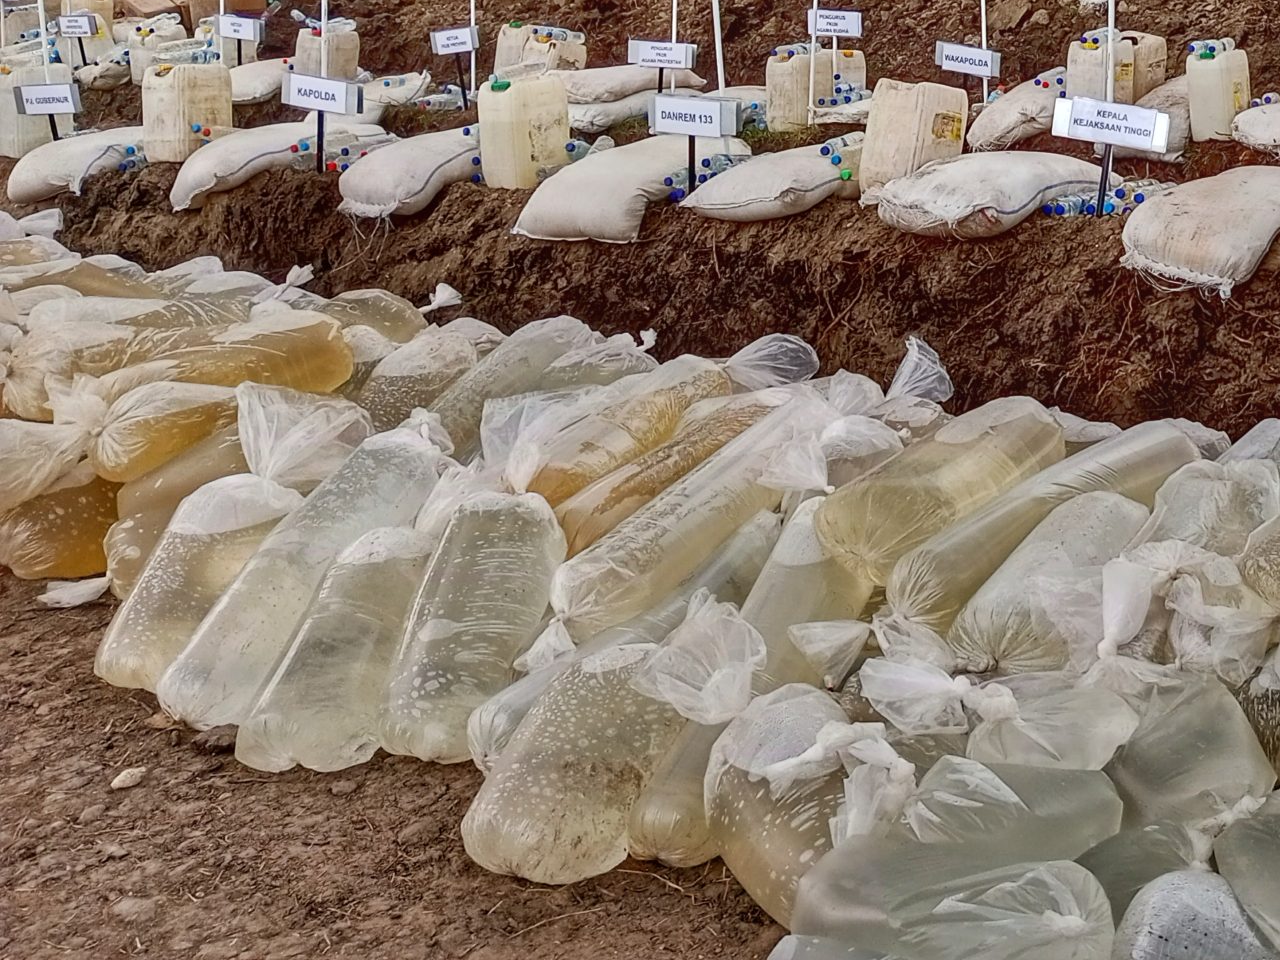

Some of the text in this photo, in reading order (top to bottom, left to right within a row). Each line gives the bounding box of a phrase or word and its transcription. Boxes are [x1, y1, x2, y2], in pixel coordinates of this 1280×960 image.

[944, 53, 989, 67] WAKAPOLDA
[297, 87, 337, 102] KAPOLDA
[661, 110, 713, 124] DANREM 133
[1096, 109, 1129, 122] KEPALA
[1072, 117, 1152, 138] KEJAKSAAN TINGGI
